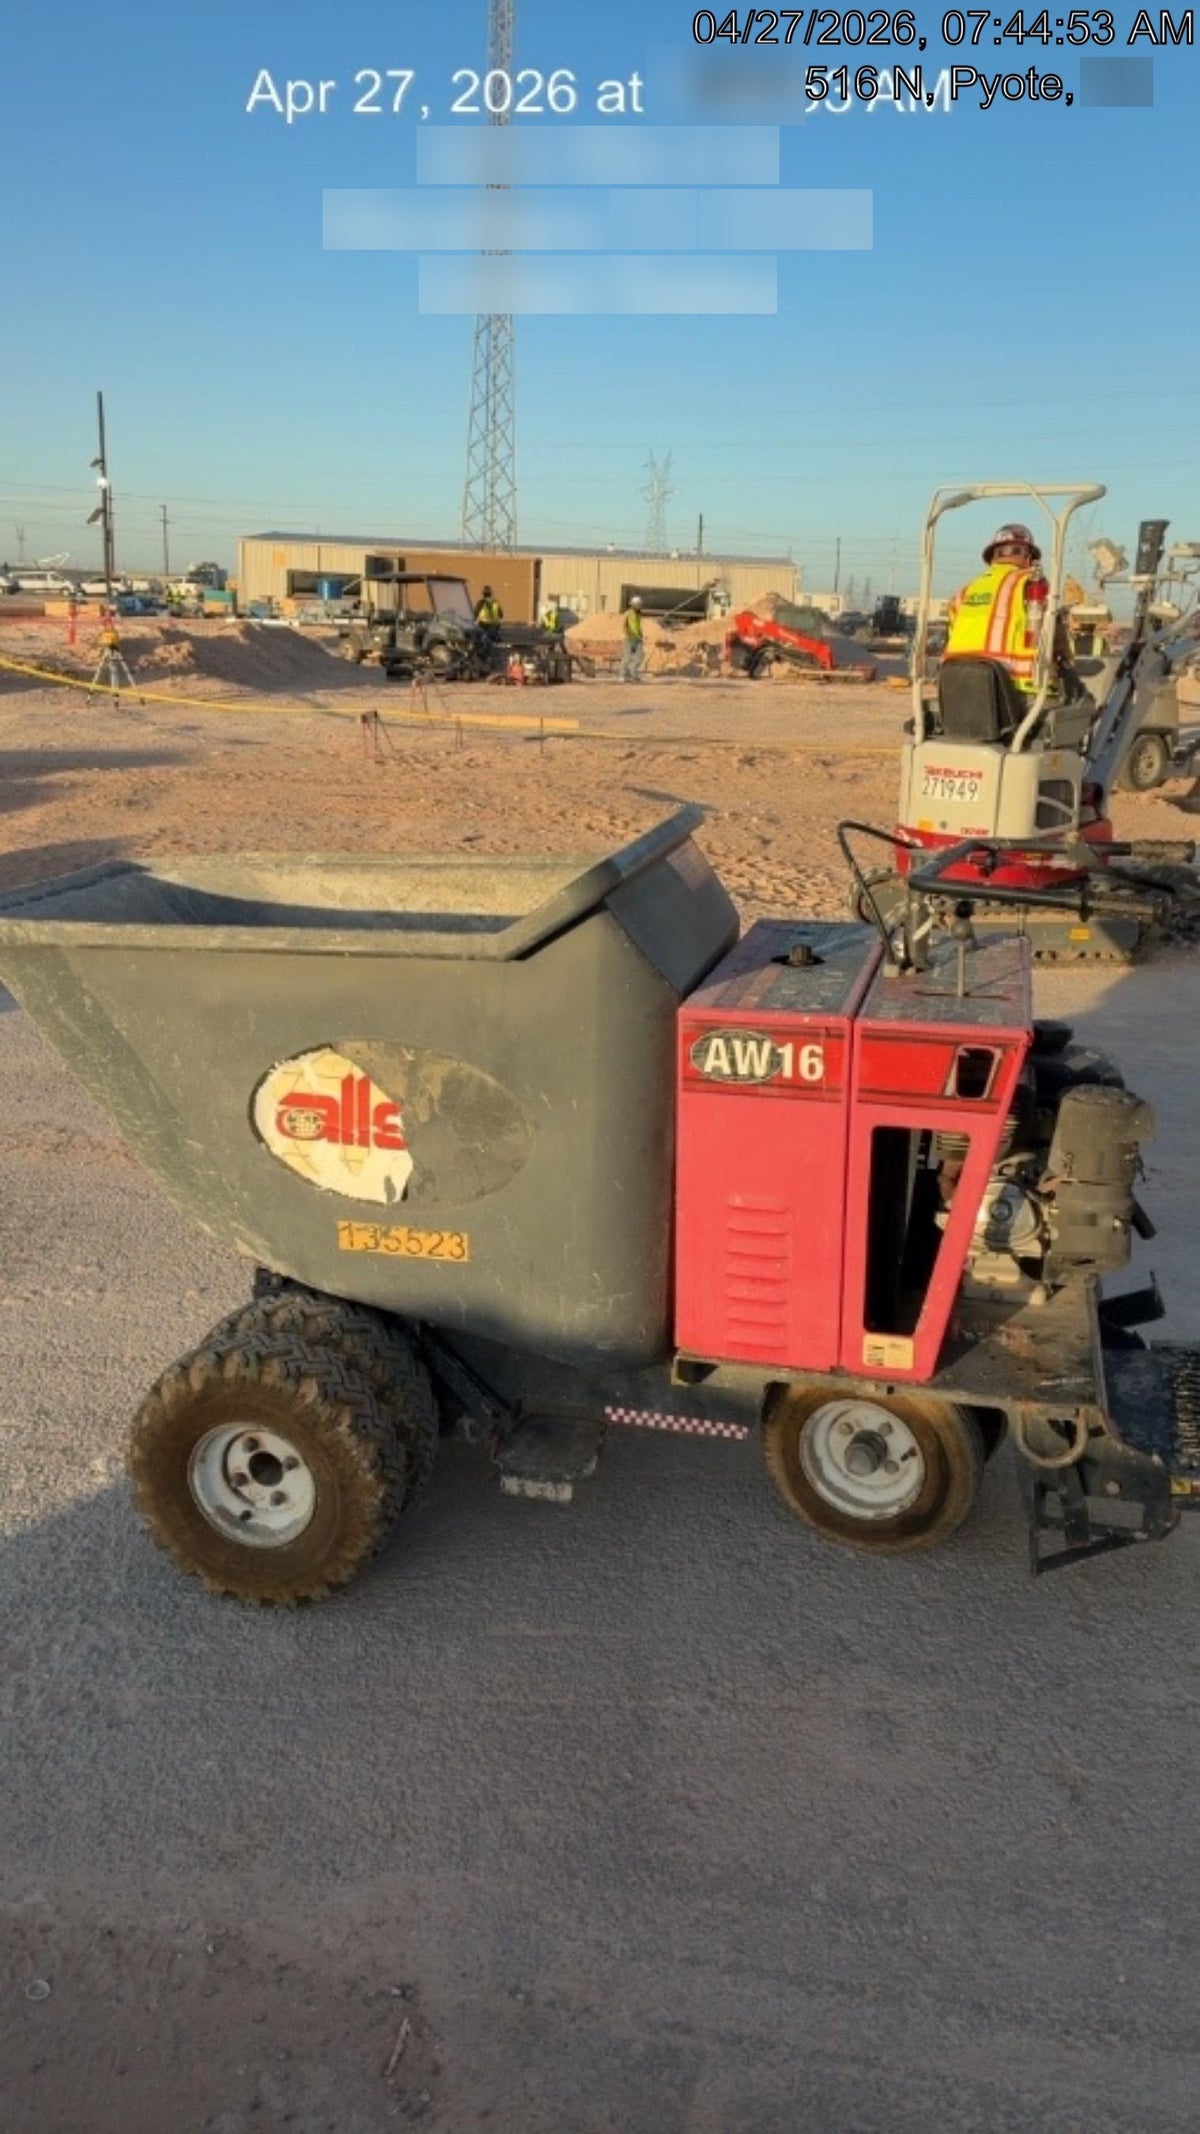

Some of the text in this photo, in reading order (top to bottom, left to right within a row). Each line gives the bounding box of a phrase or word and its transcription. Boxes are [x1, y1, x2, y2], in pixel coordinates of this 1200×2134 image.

[921, 776, 978, 801] 271949
[703, 1037, 825, 1081] AW16
[339, 1222, 466, 1260] 135523
